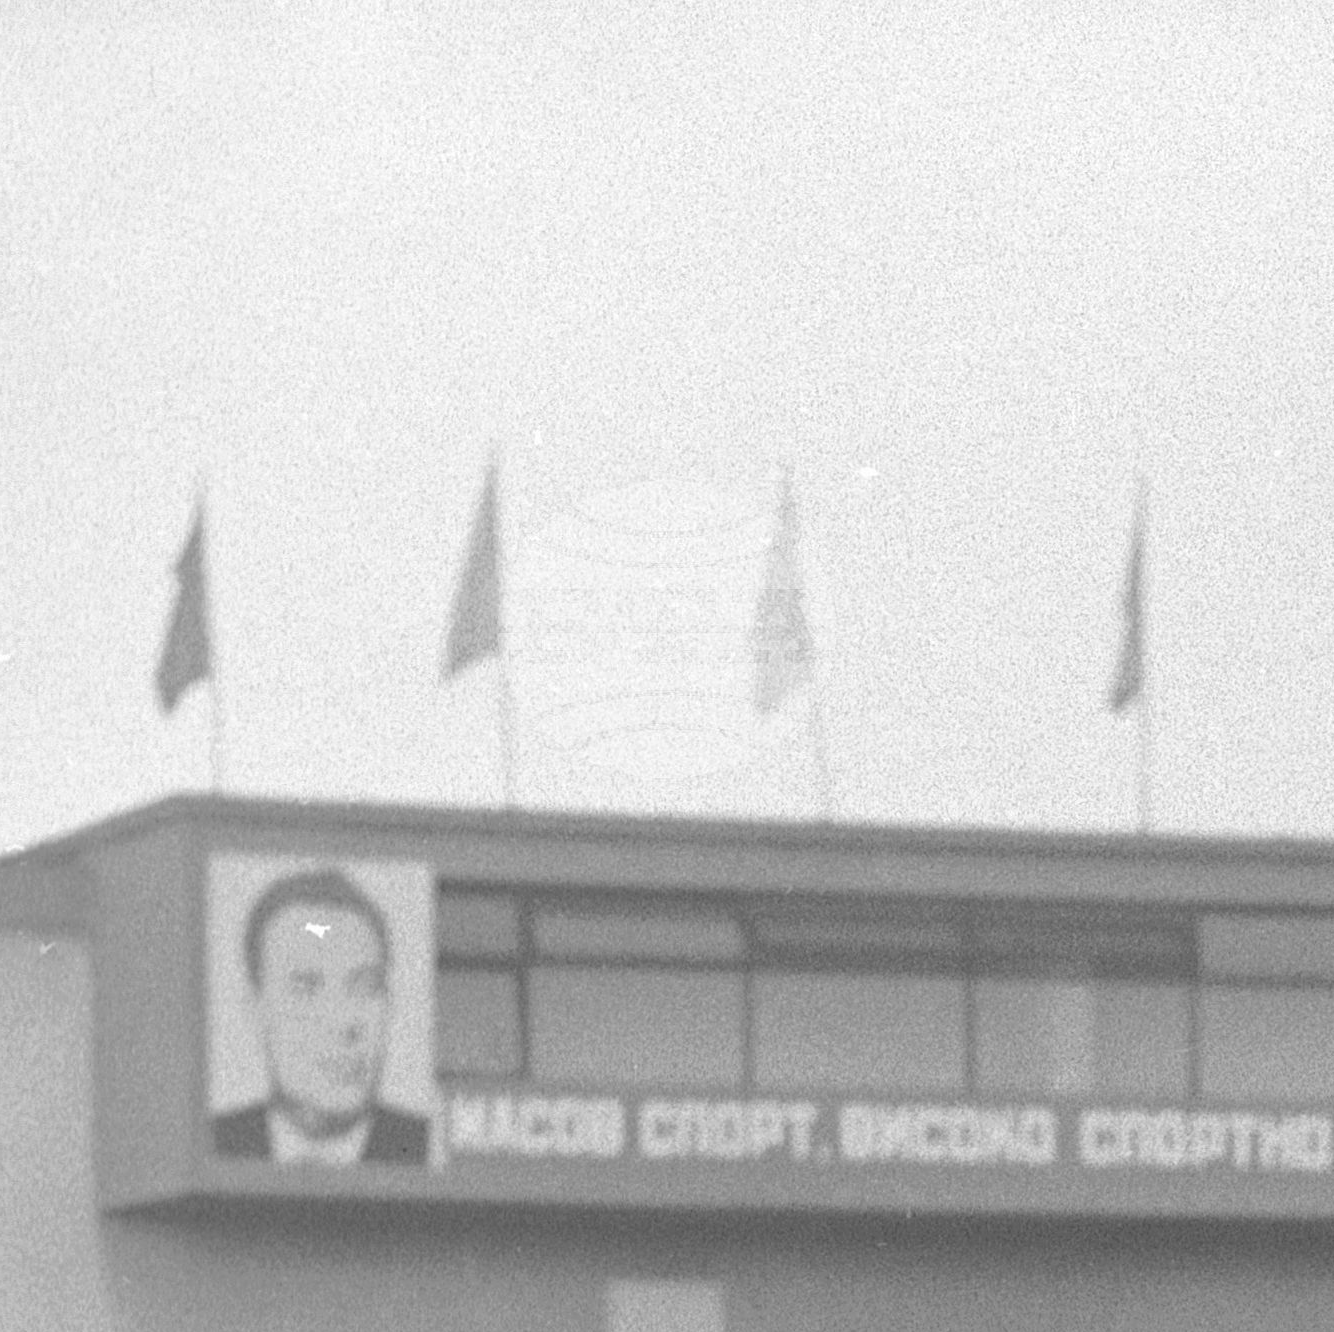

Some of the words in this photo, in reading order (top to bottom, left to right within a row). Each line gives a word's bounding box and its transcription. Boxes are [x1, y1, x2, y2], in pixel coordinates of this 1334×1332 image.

[450, 1095, 624, 1158] МАСОВ
[838, 1102, 1056, 1164] ВИСОКО
[1079, 1108, 1334, 1170] СПОРТНО
